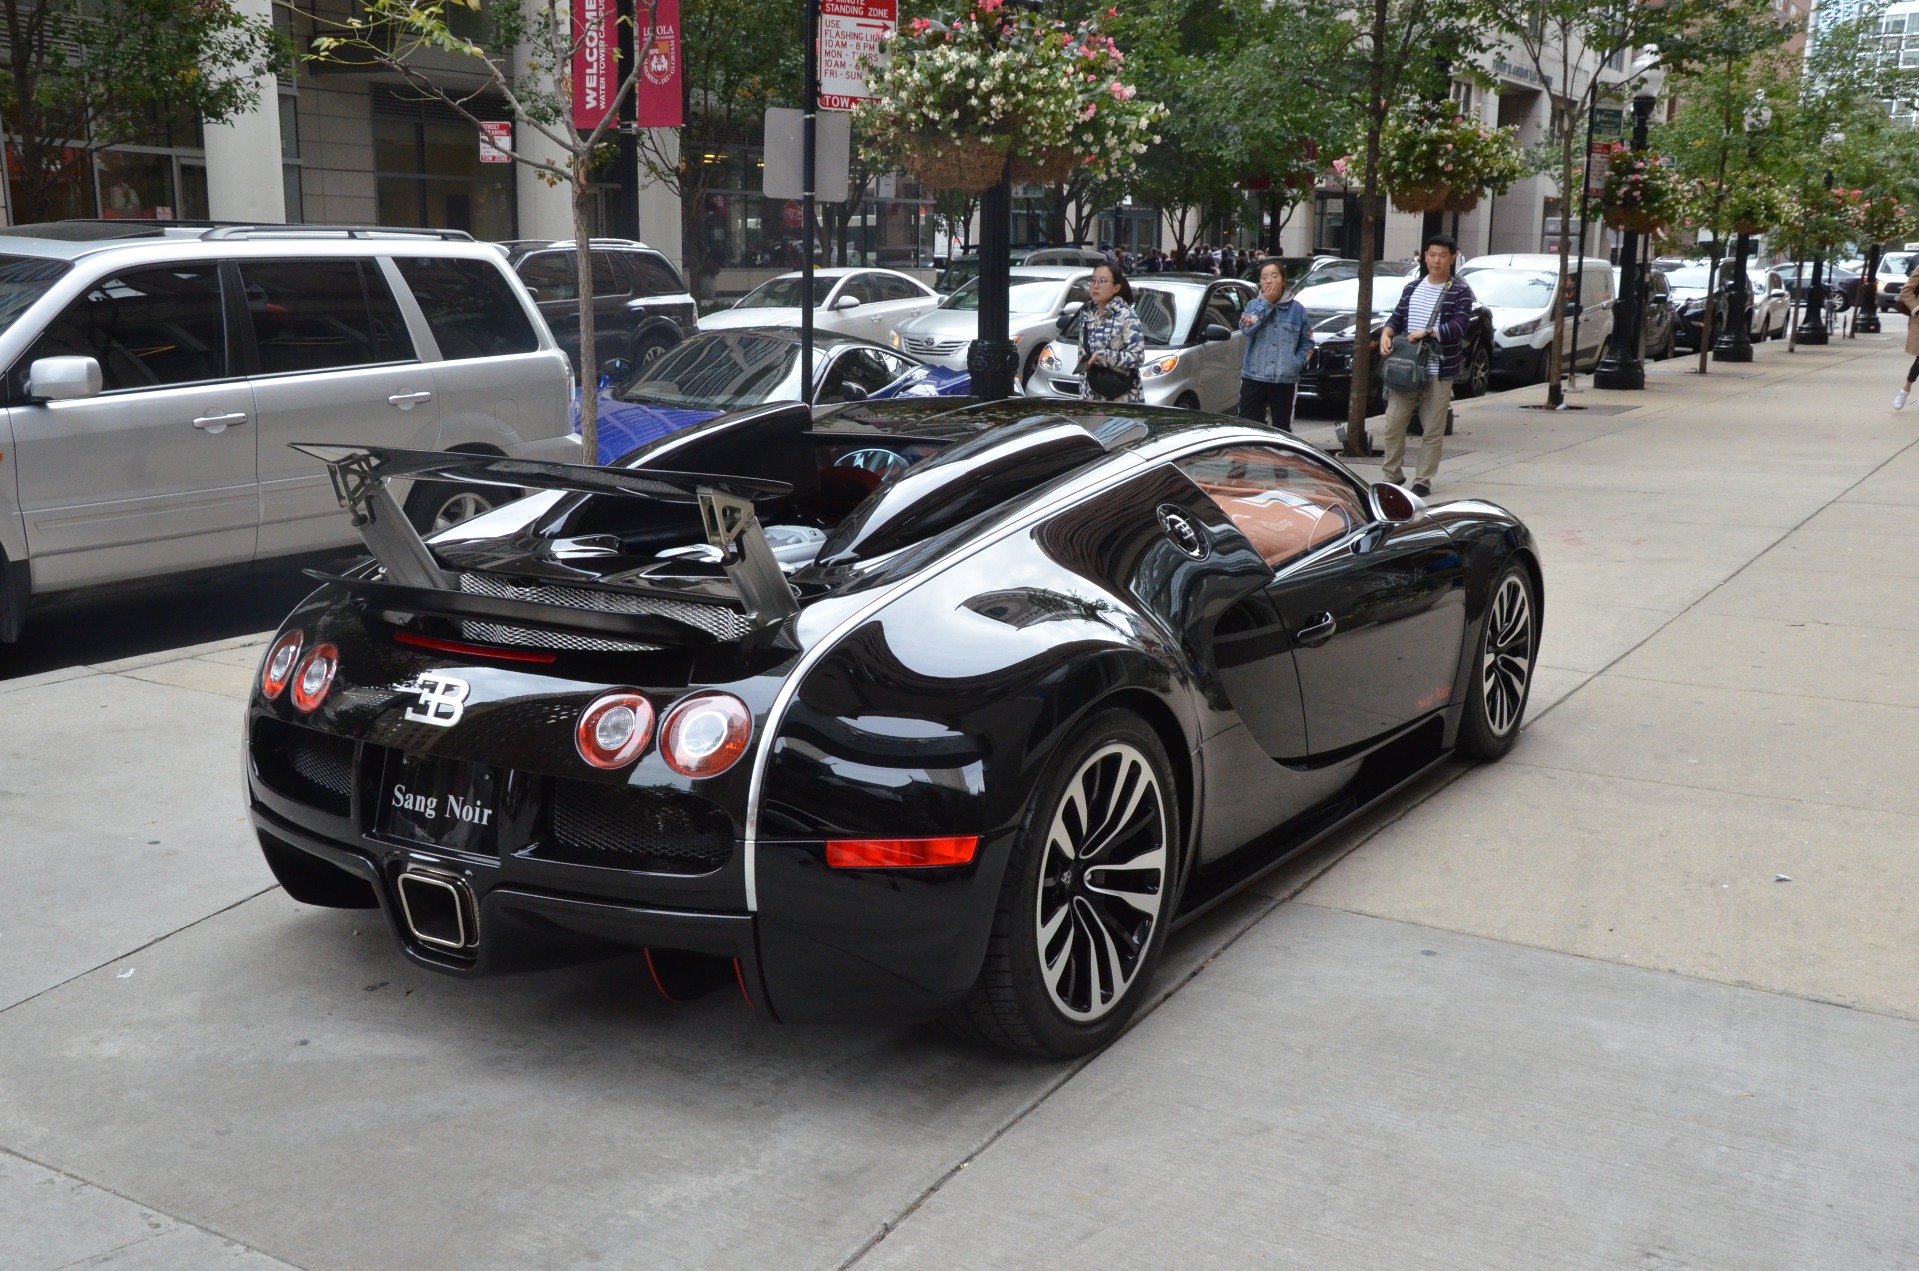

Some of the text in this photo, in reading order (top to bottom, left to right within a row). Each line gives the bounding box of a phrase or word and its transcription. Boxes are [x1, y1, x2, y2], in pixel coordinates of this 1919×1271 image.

[826, 3, 888, 18] STANDING ZONE
[824, 19, 841, 28] USE
[643, 25, 674, 36] LOOLA
[824, 29, 863, 41] FLASHING
[864, 43, 875, 52] PM
[585, 0, 598, 110] WELCOME
[824, 49, 842, 58] MON
[824, 69, 838, 78] FRI
[846, 71, 862, 80] SUN
[824, 96, 850, 108] TOW
[392, 784, 493, 825] Sang Noir
